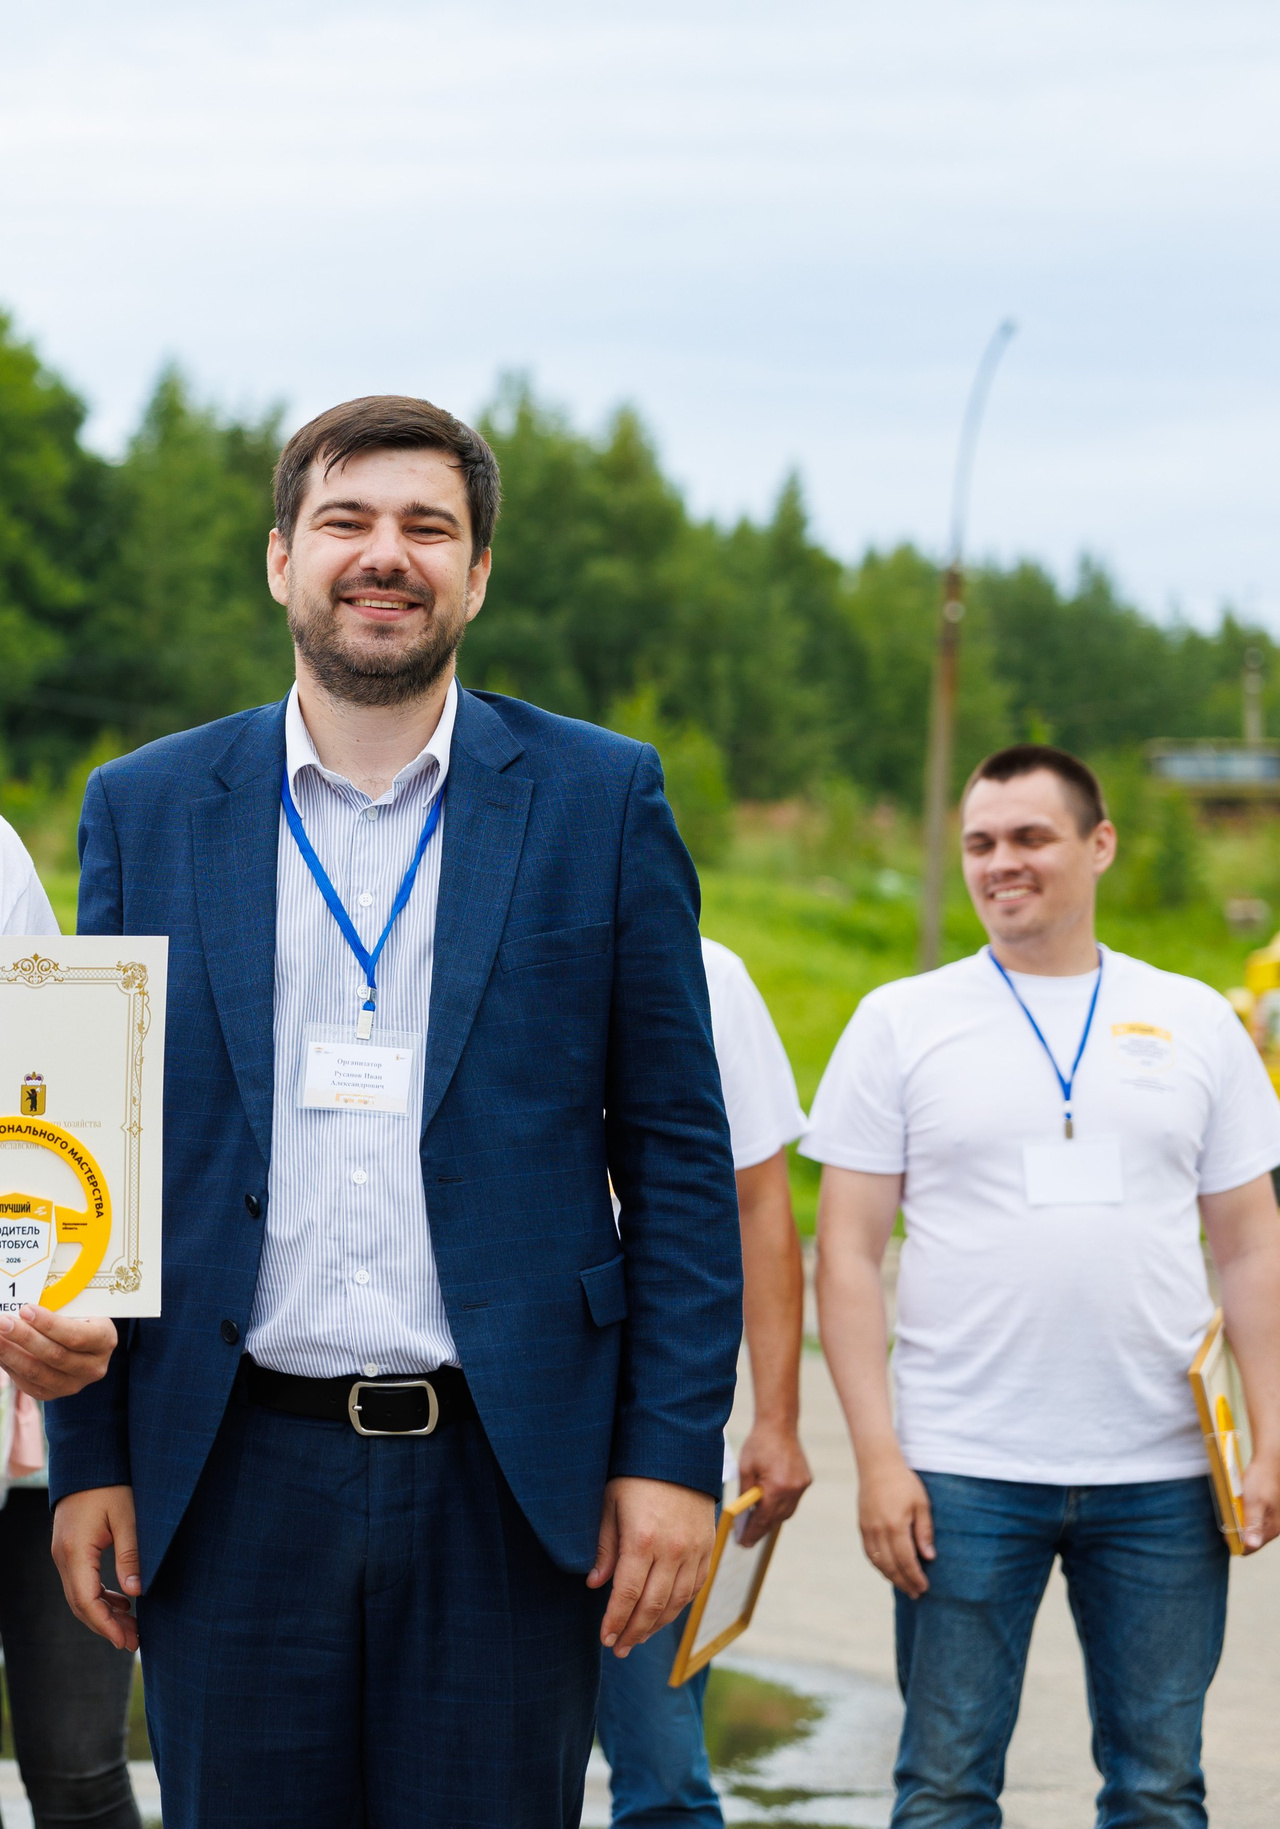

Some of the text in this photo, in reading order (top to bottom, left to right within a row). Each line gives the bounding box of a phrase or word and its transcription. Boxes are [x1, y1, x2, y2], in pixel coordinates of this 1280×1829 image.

[337, 1058, 382, 1069] Организатор
[364, 1072, 383, 1080] Иван
[330, 1080, 385, 1090] Александрович
[63, 1119, 102, 1128] хозяйства
[68, 1147, 104, 1219] МАСТЕРСТВА
[8, 1282, 17, 1297] 1
